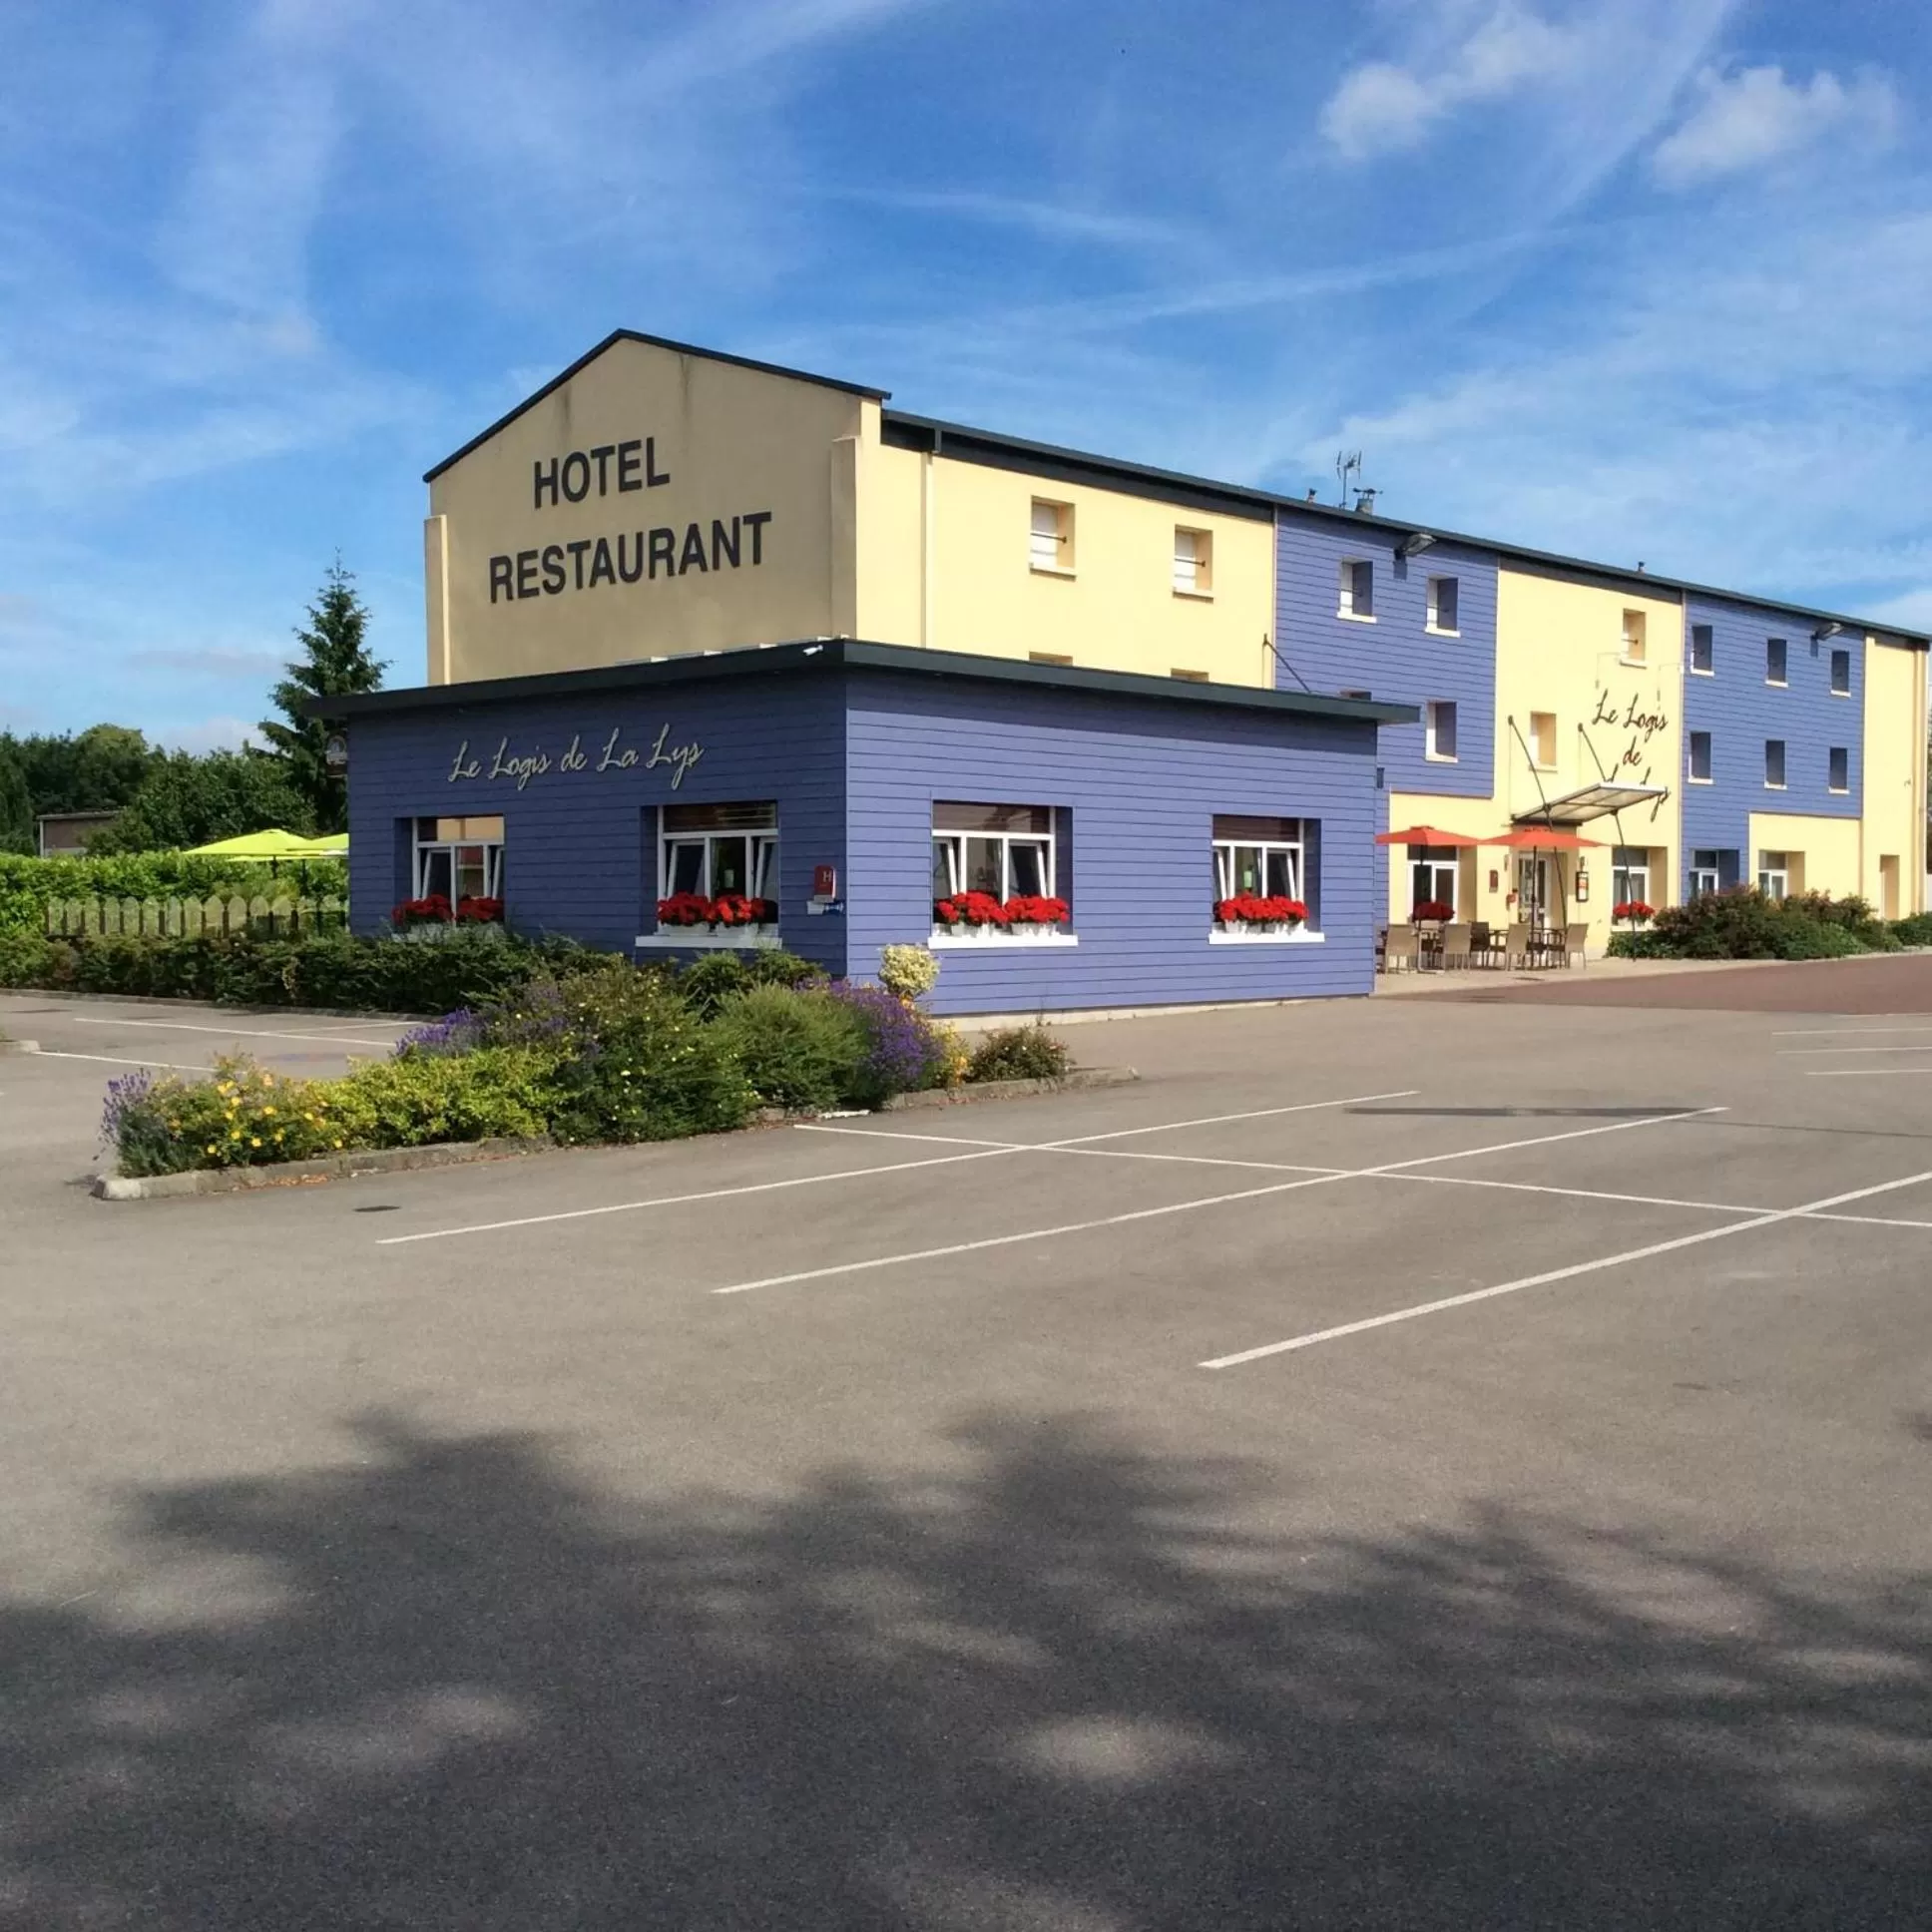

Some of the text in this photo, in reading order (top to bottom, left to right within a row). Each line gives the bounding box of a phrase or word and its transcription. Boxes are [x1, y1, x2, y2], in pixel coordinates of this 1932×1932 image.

[534, 437, 670, 508] HOTEL
[489, 512, 772, 603] RESTAURANT
[1592, 689, 1669, 742] Le Logis
[448, 723, 705, 790] Le Logis de La Lys
[1623, 735, 1643, 766] de
